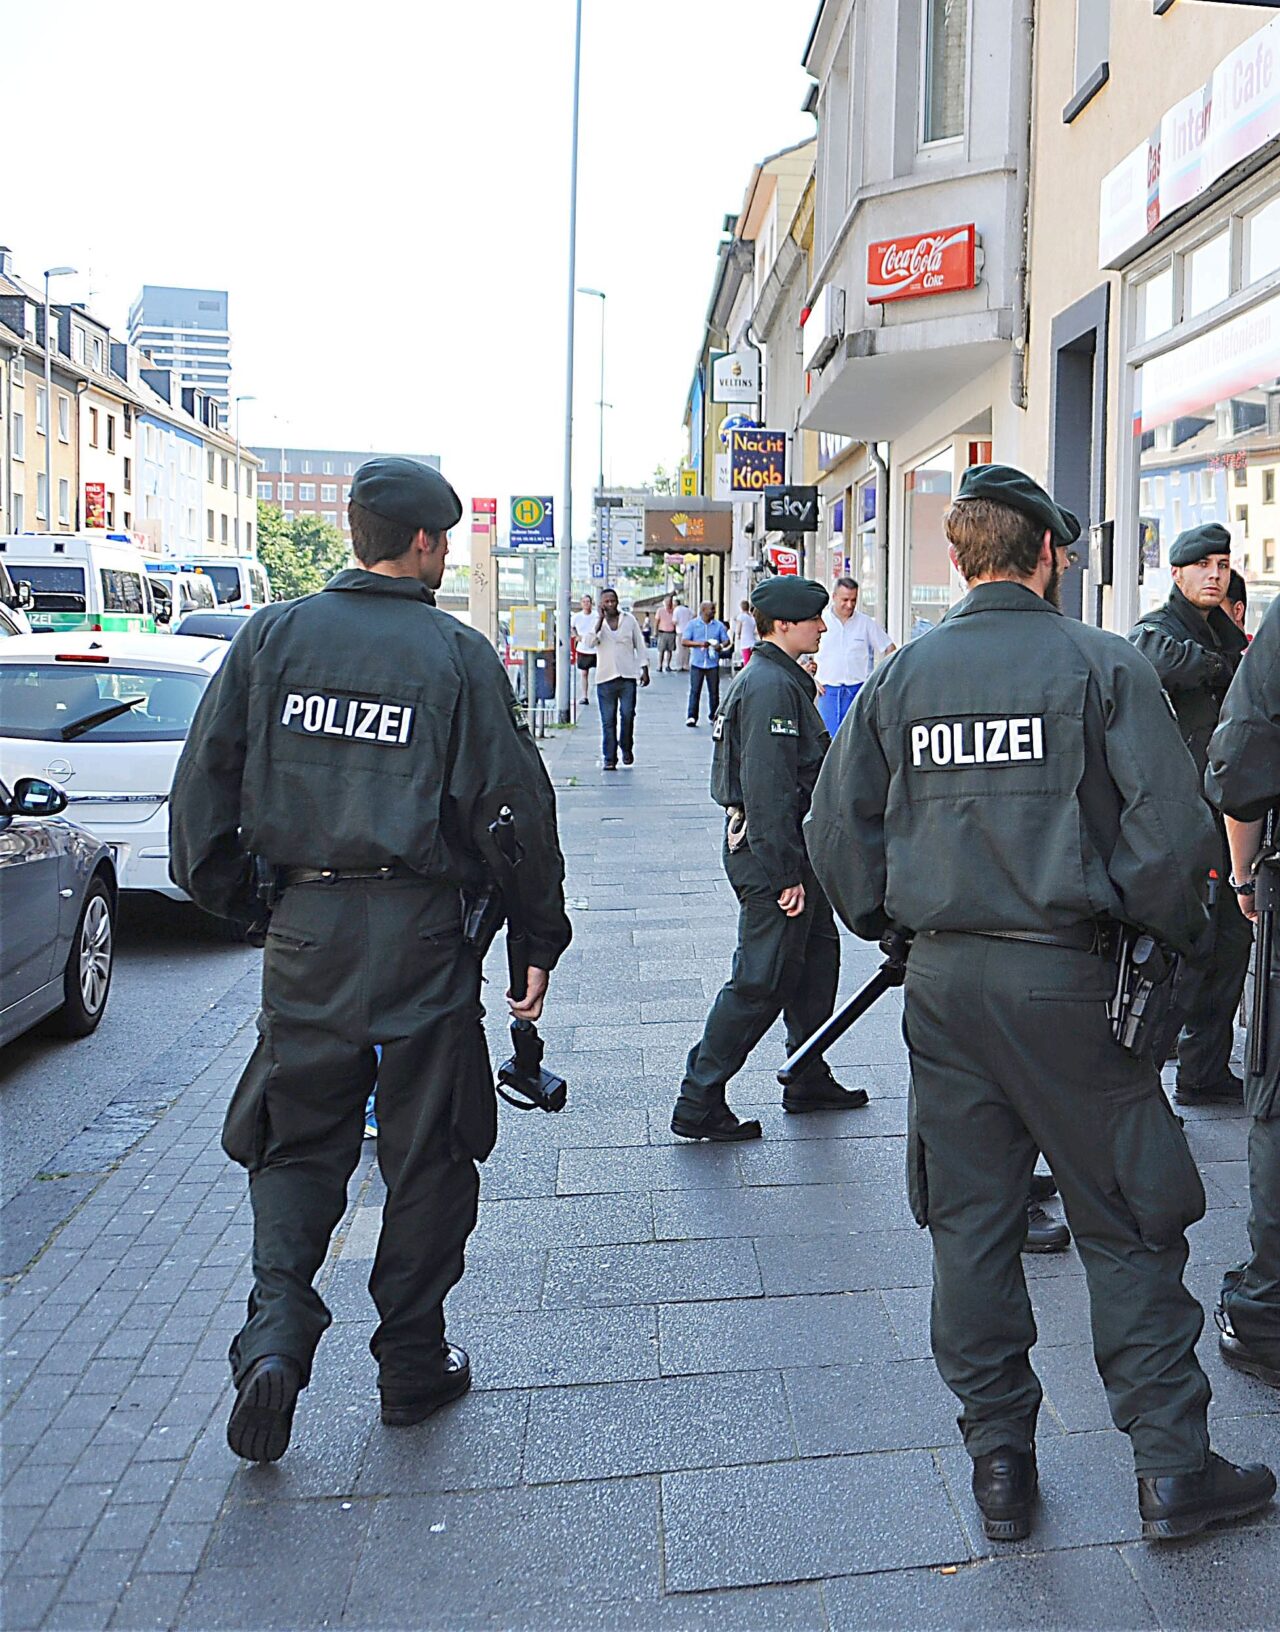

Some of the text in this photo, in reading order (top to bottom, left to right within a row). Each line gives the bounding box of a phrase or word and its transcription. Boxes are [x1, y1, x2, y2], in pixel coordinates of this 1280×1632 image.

[881, 236, 945, 279] Coca-Cola
[923, 272, 944, 288] Coke
[719, 379, 753, 388] VELTINS
[734, 431, 784, 453] Nacht
[544, 502, 552, 515] 2
[770, 495, 812, 521] sky
[281, 693, 414, 744] POLIZEI
[911, 717, 1044, 766] POLIZEI
